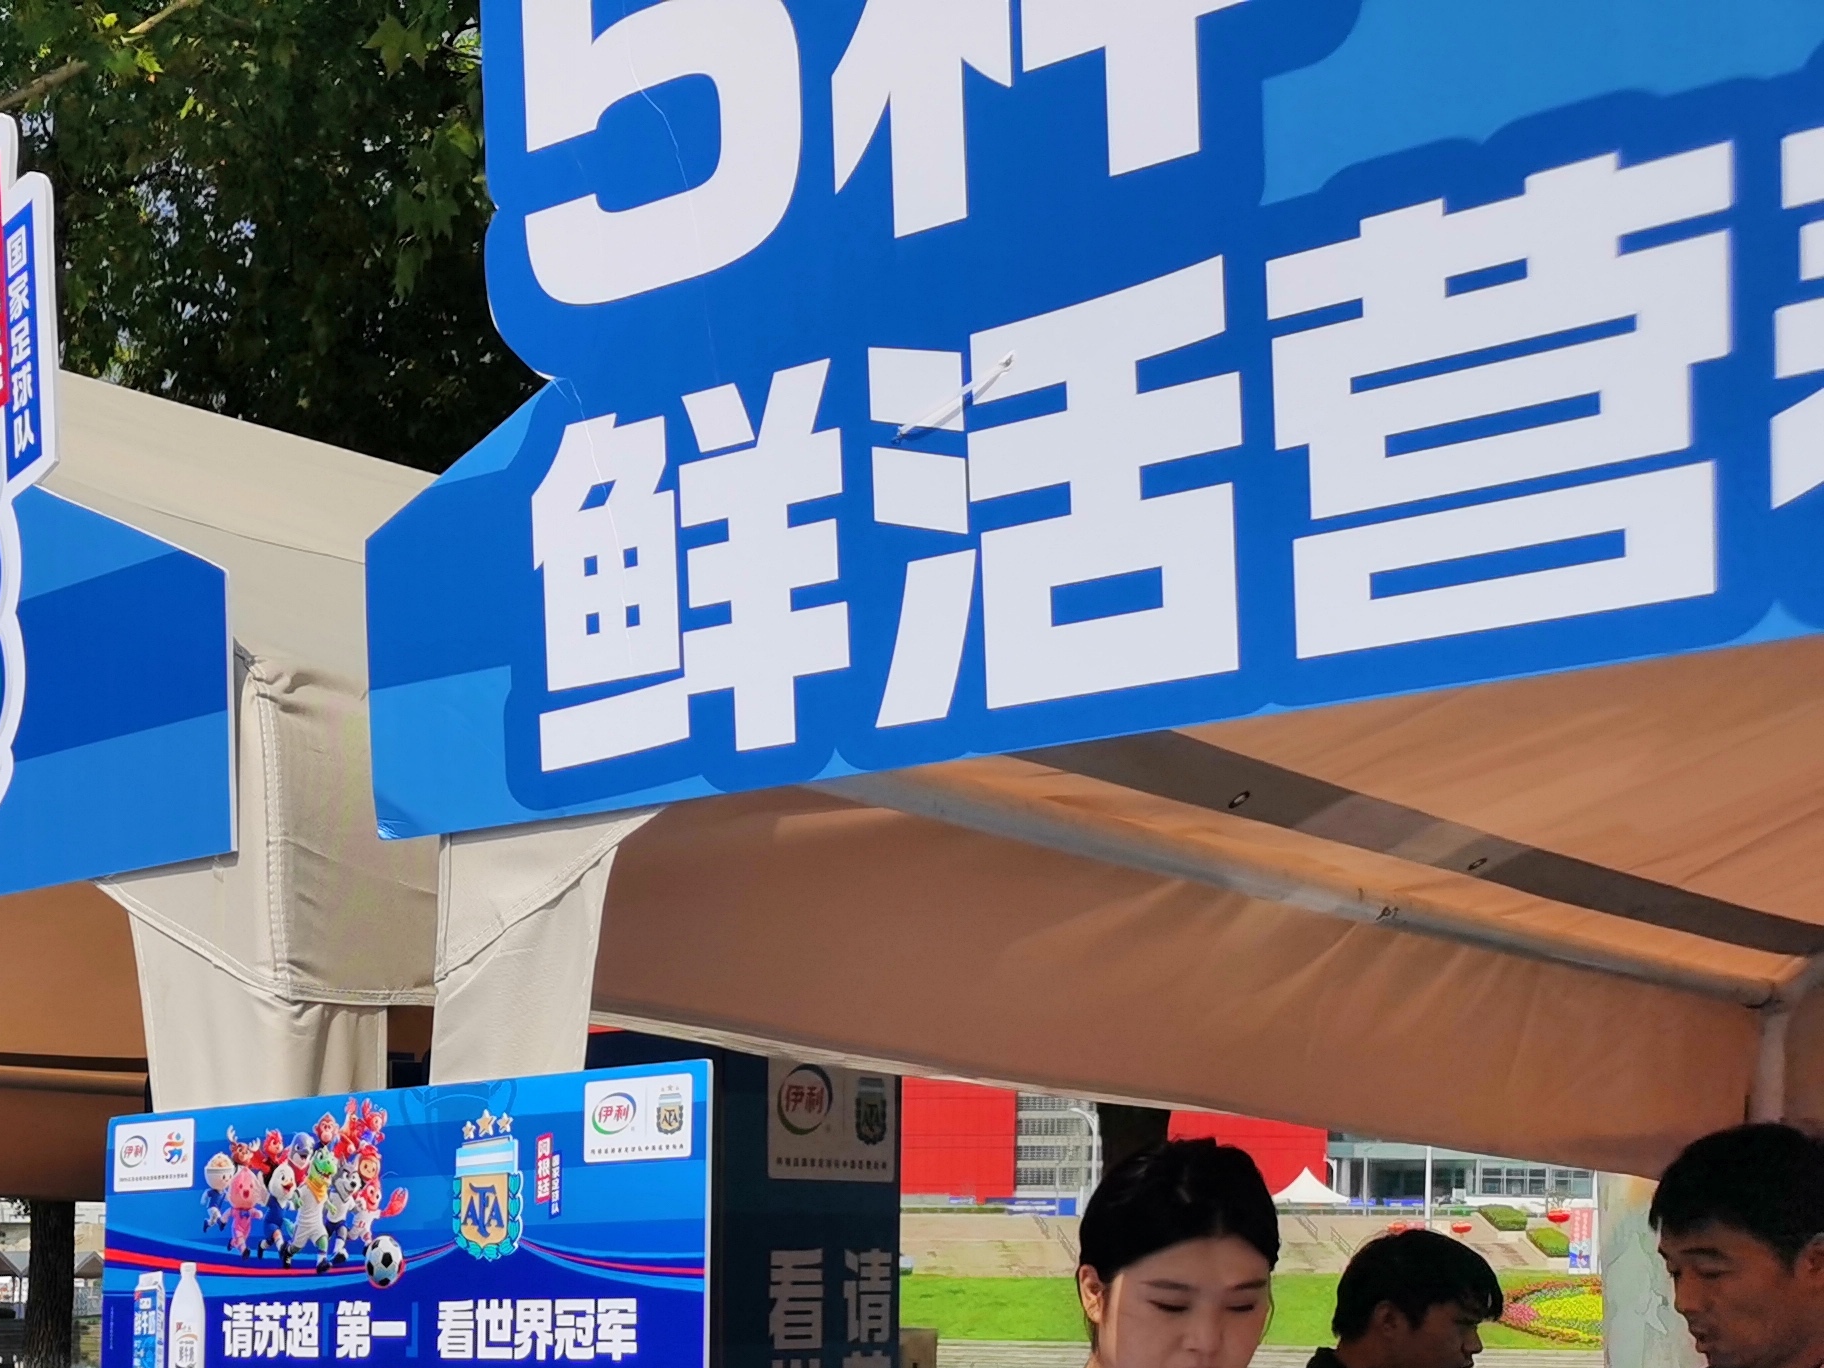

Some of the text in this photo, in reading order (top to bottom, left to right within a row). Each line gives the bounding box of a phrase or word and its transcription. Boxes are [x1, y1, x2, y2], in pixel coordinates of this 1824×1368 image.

[5, 224, 36, 461] 国家足球队
[531, 123, 1824, 771] 鲜活营
[598, 1103, 629, 1123] 伊利
[785, 1084, 825, 1115] 伊利
[124, 1144, 143, 1159] 伊利
[537, 1137, 551, 1199] 阿根廷
[437, 1298, 638, 1361] 看世界冠军
